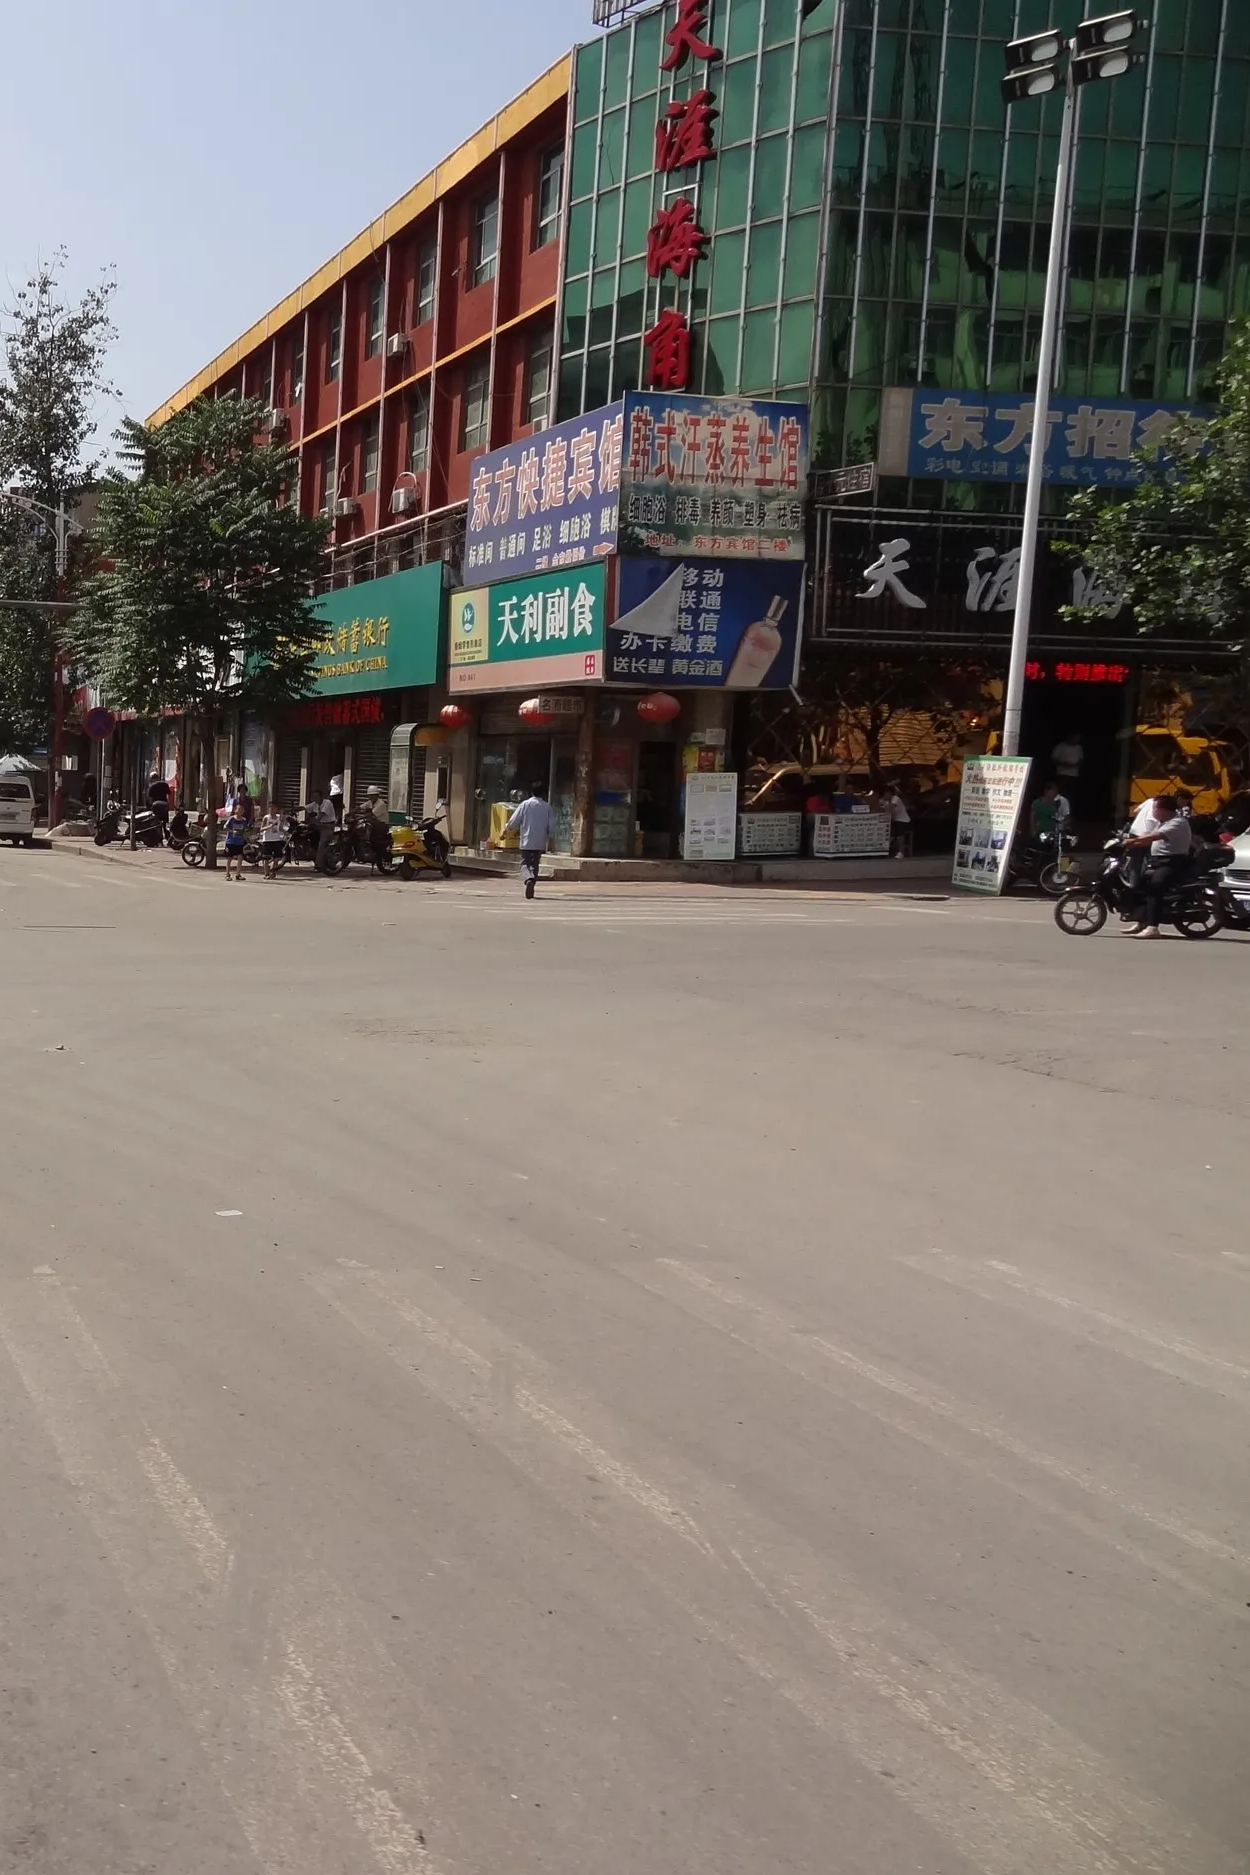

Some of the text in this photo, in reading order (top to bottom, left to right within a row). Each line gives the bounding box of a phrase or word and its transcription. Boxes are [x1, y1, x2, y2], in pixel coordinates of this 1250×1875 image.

[645, 0, 722, 391] 天涯海角
[630, 406, 801, 490] 韩式汗蒸养生馆
[470, 413, 623, 532] 东方快捷宾馆
[628, 493, 666, 524] 细胞浴
[675, 495, 700, 525] 排毒
[710, 498, 735, 527] 养颜
[743, 500, 767, 528] 塑身
[468, 541, 493, 567] 标准间
[499, 532, 526, 561] 普通间
[532, 524, 552, 552] 足浴
[559, 512, 592, 544] 细胞浴
[694, 535, 789, 551] 东方宾馆二楼
[682, 567, 724, 587] 移动
[680, 590, 721, 609] 联通
[497, 582, 595, 647] 天利副食
[678, 612, 720, 632] 电信
[620, 632, 717, 654] 办卡缴费
[613, 657, 665, 674] 送长辈
[672, 658, 723, 675] 黄金酒
